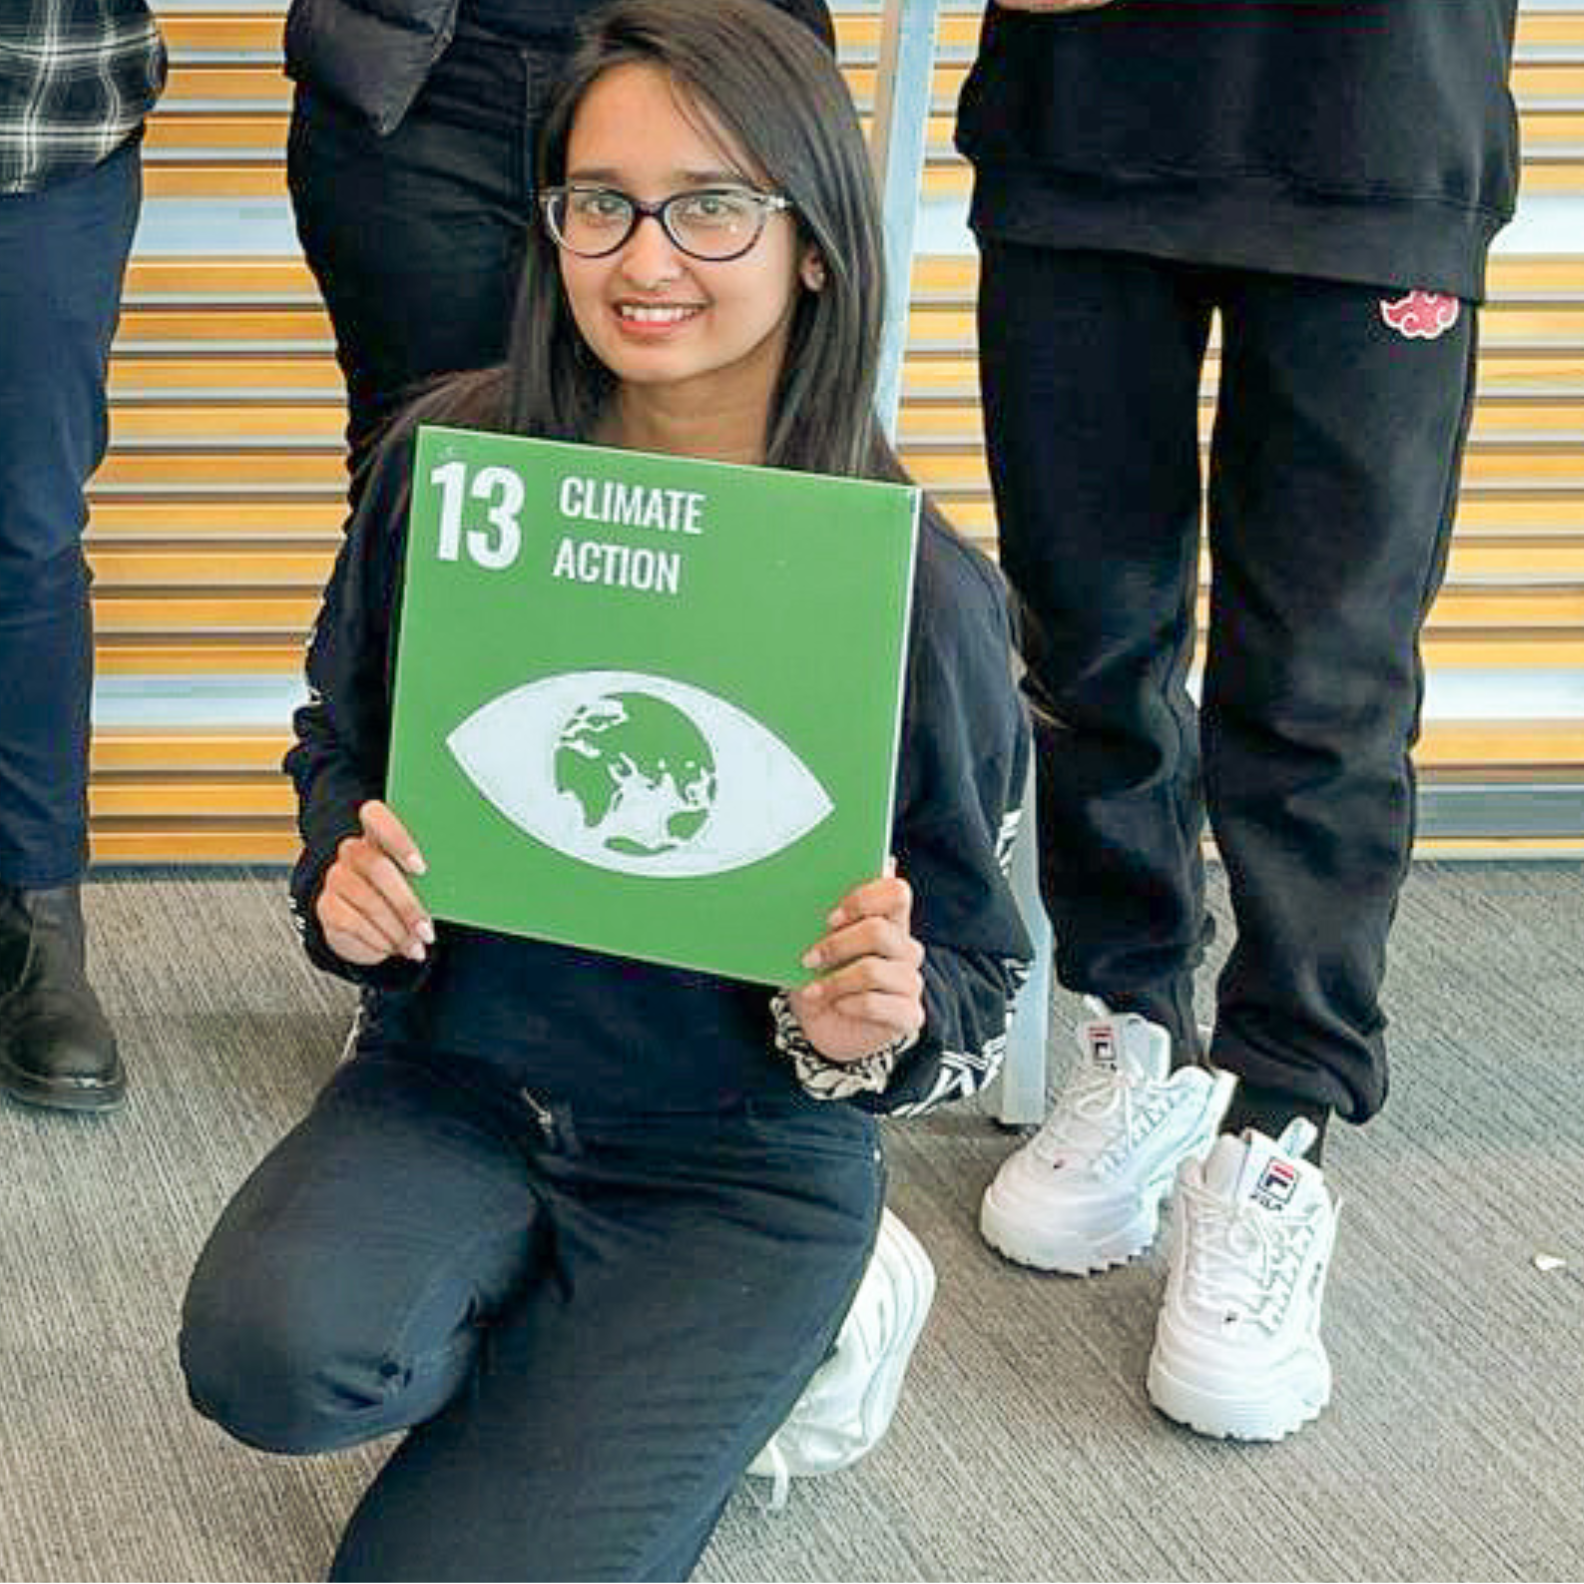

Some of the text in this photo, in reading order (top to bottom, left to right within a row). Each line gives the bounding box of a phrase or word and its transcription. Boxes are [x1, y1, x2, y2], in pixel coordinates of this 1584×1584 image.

[431, 462, 524, 568] 13
[560, 477, 705, 534] CLIMATE
[553, 538, 680, 593] ACTION
